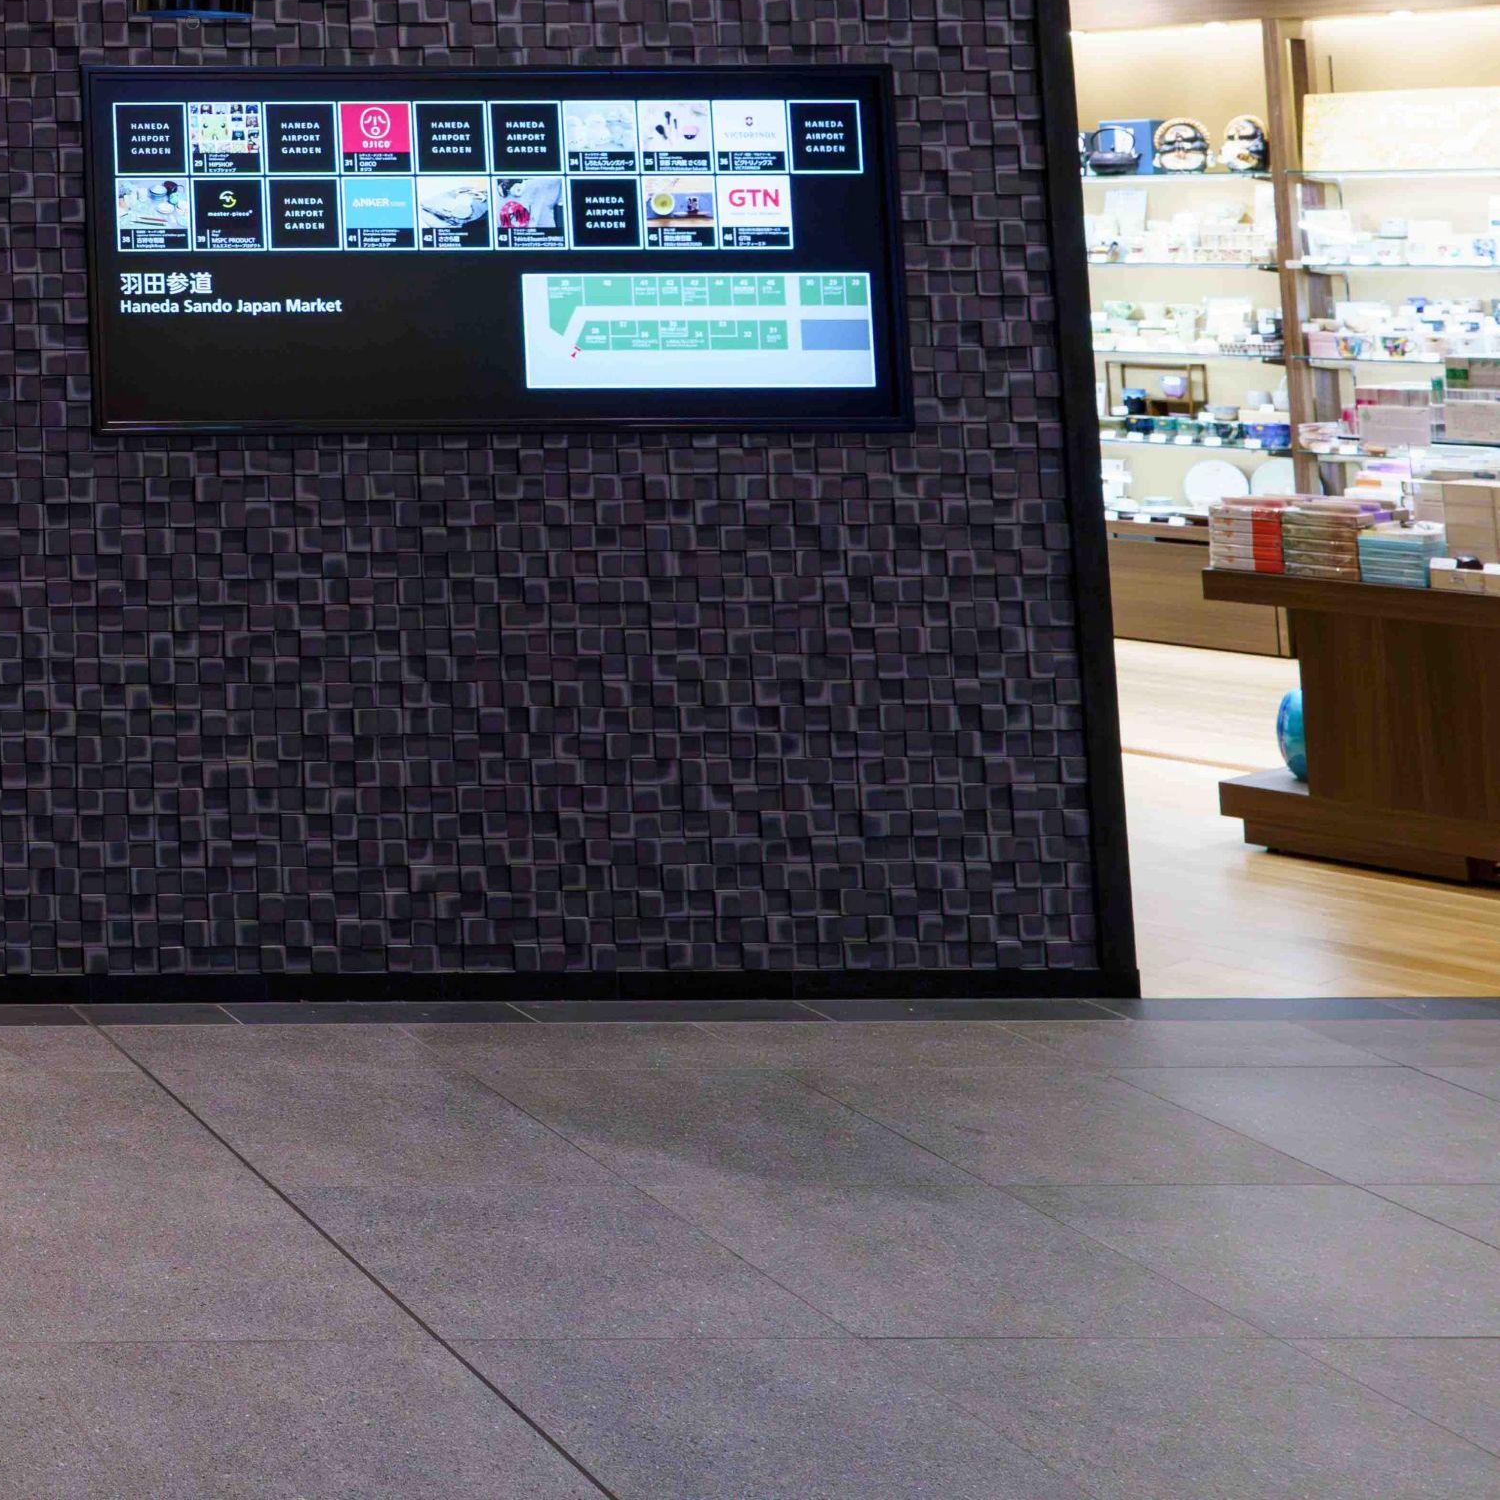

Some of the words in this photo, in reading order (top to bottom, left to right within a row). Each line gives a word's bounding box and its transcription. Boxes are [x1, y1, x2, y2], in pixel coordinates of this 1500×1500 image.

[344, 159, 353, 167] 31
[729, 189, 779, 207] GTN
[120, 272, 213, 295] 羽田参道
[120, 299, 180, 313] Haneda
[184, 298, 233, 313] Sando
[236, 299, 281, 316] Japan
[286, 298, 343, 313] Market
